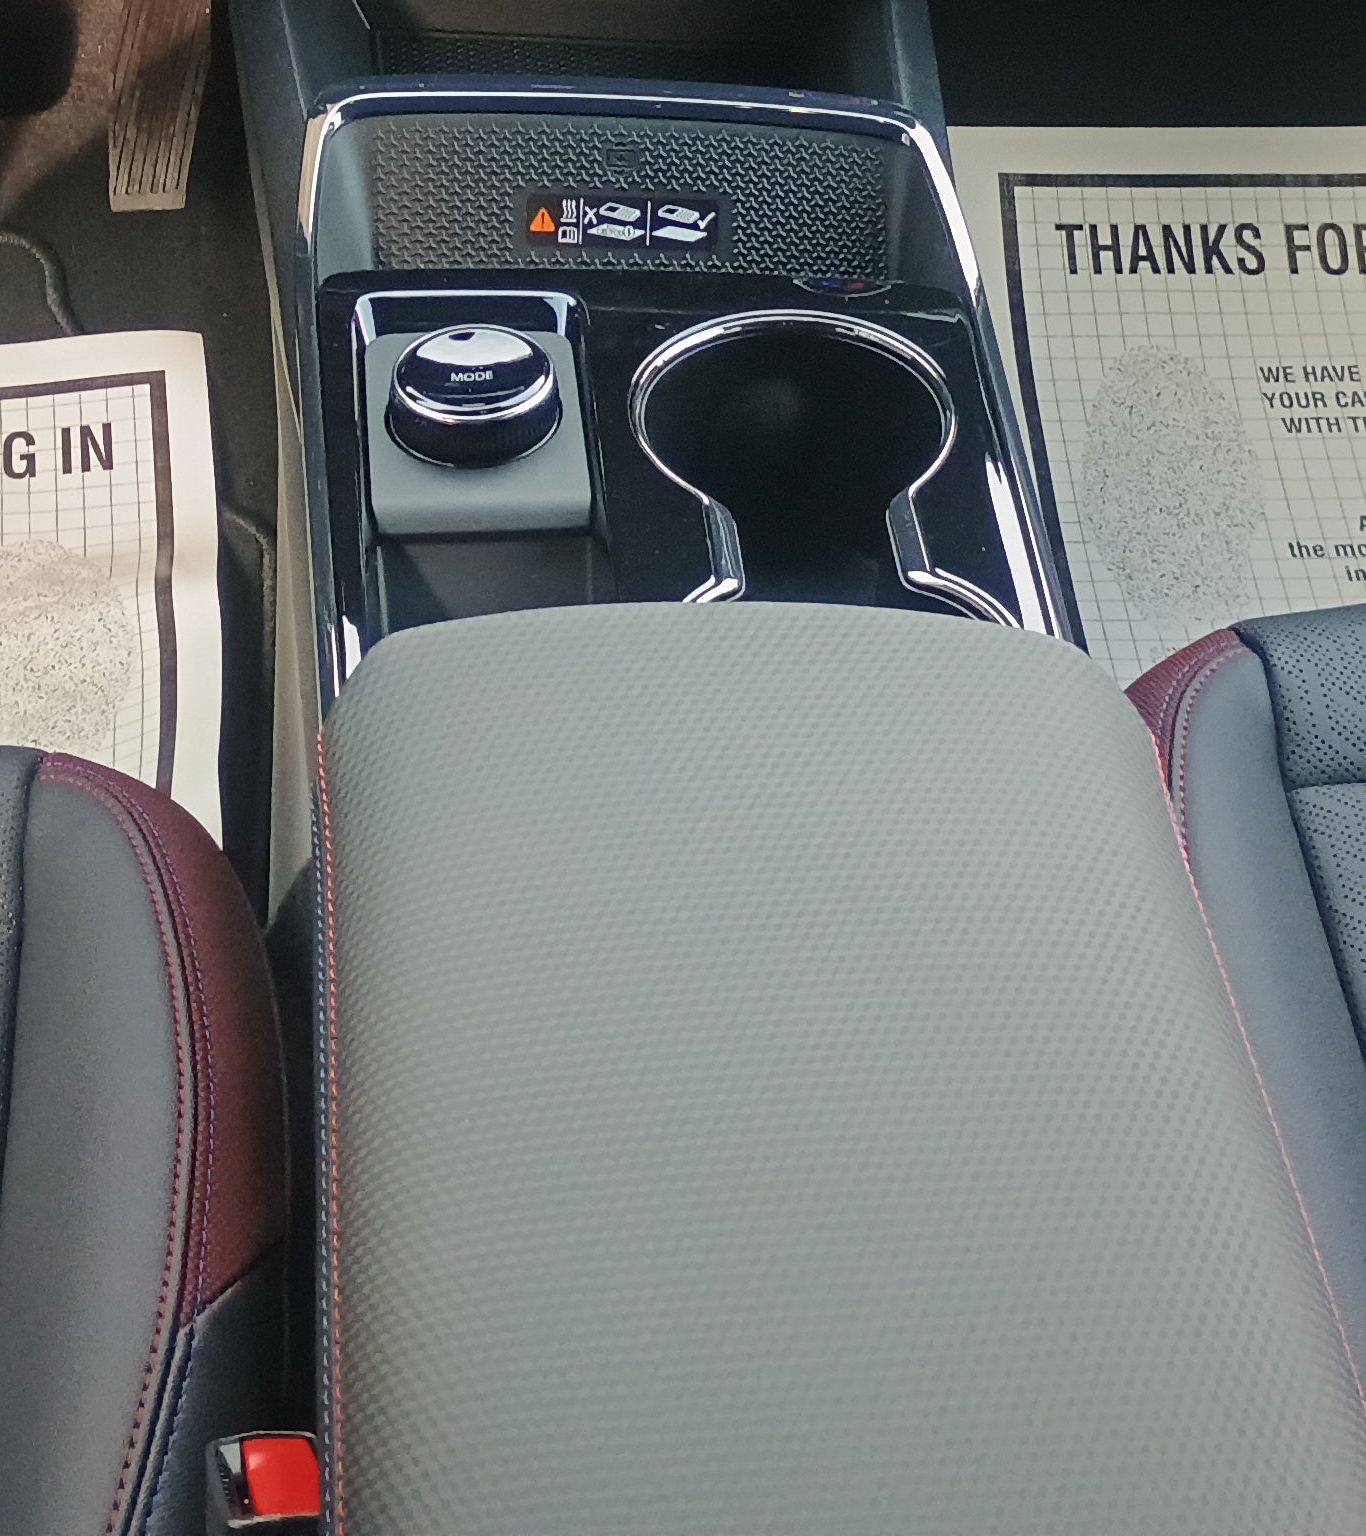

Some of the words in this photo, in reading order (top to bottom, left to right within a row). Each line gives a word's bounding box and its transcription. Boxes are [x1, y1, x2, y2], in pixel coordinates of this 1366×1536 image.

[1055, 221, 1267, 278] THANKS
[450, 371, 493, 382] MODE
[1259, 365, 1296, 384] WE
[1303, 365, 1362, 383] HAVE
[1263, 391, 1328, 409] YOUR
[1281, 416, 1343, 434] WITH
[60, 422, 116, 474] IN
[1288, 541, 1326, 559] the
